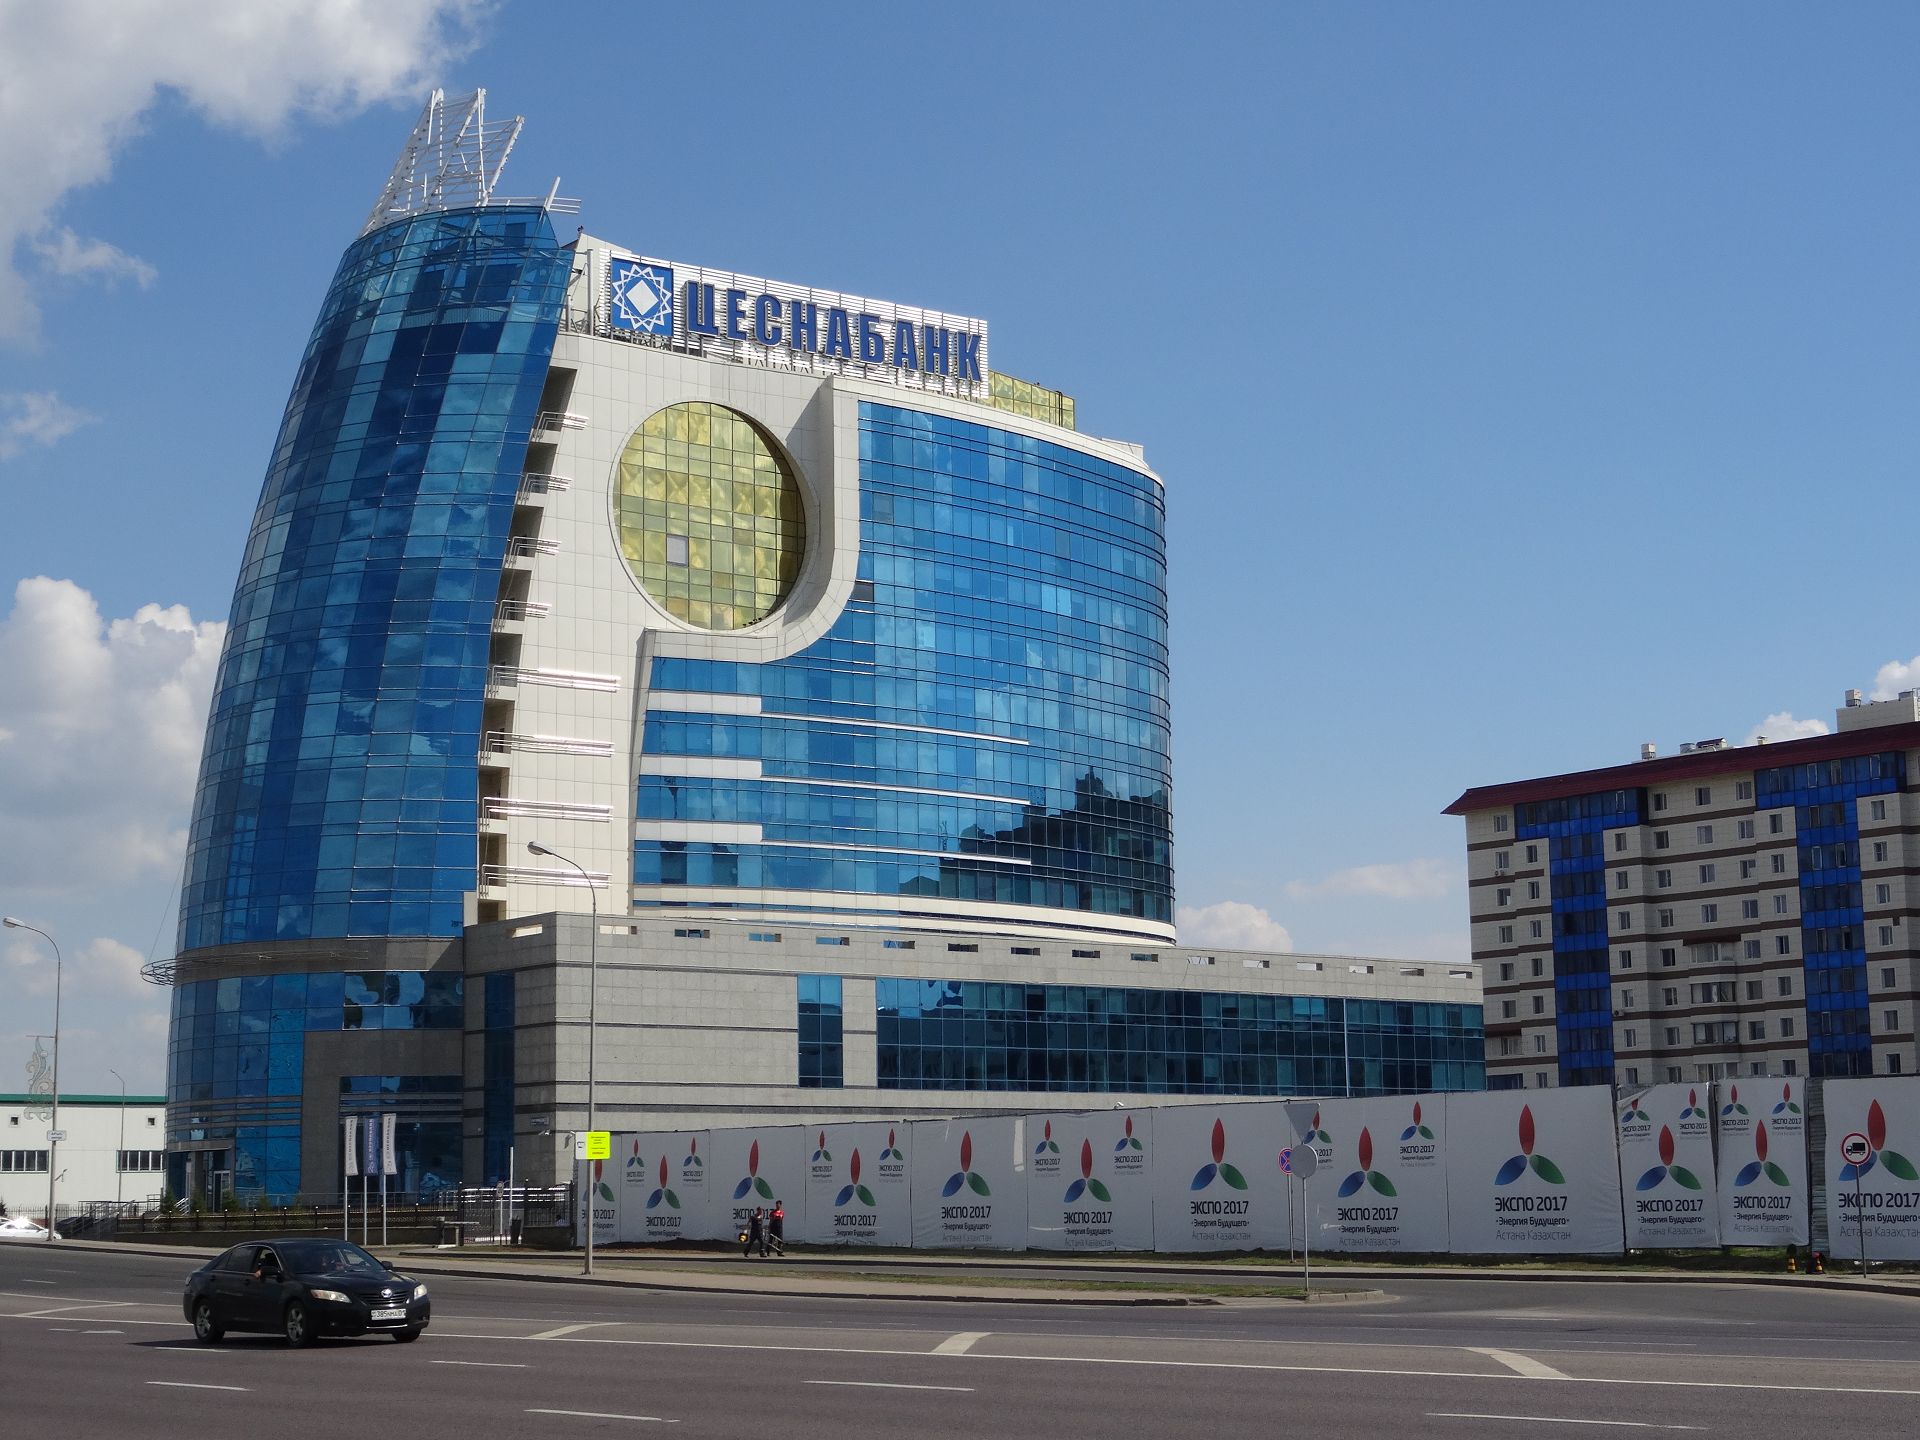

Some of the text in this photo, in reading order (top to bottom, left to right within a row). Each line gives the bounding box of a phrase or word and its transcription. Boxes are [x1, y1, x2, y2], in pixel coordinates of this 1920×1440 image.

[686, 280, 982, 382] ЦЕСНАБАНК
[1318, 1148, 1333, 1157] 2017
[1400, 1145, 1435, 1154] ЭКСПО 2017
[1131, 1155, 1144, 1163] 2017
[1495, 1196, 1568, 1212] ЭКСПО 2017
[1636, 1199, 1704, 1212] ЭКСПО 2017
[1733, 1196, 1791, 1209] ЭКСПО 2017
[1838, 1192, 1920, 1208] ЭКСПО 2017
[600, 1209, 615, 1219] 2017
[732, 1208, 755, 1220] ЭКСПО
[941, 1205, 992, 1219] ЭКСПО 2017
[1191, 1201, 1249, 1215] ЭКСПО 2017
[1337, 1207, 1399, 1221] ЭКСПО 2017
[645, 1216, 682, 1227] ЭКСПО 2017
[834, 1214, 877, 1226] ЭКСПО 2017
[1063, 1211, 1113, 1224] ЭКСПО 2017
[1496, 1229, 1571, 1241] Астана Казахстан
